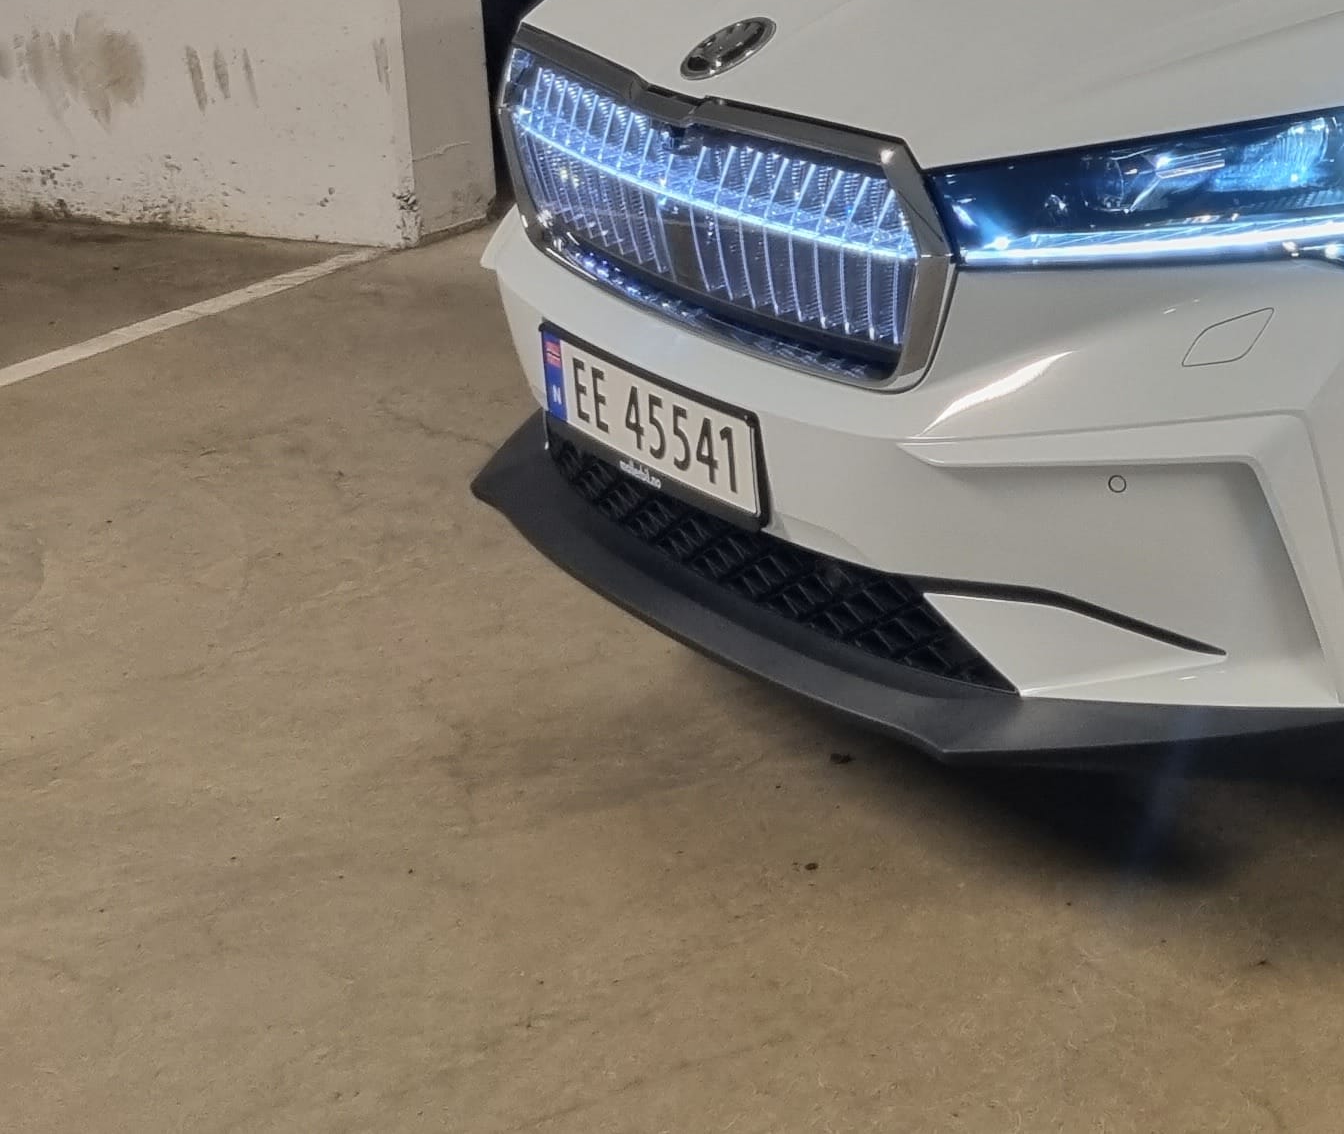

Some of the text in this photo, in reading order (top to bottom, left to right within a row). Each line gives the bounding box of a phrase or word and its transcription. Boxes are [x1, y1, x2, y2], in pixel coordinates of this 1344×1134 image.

[551, 383, 563, 406] N
[572, 357, 740, 494] EE 45541
